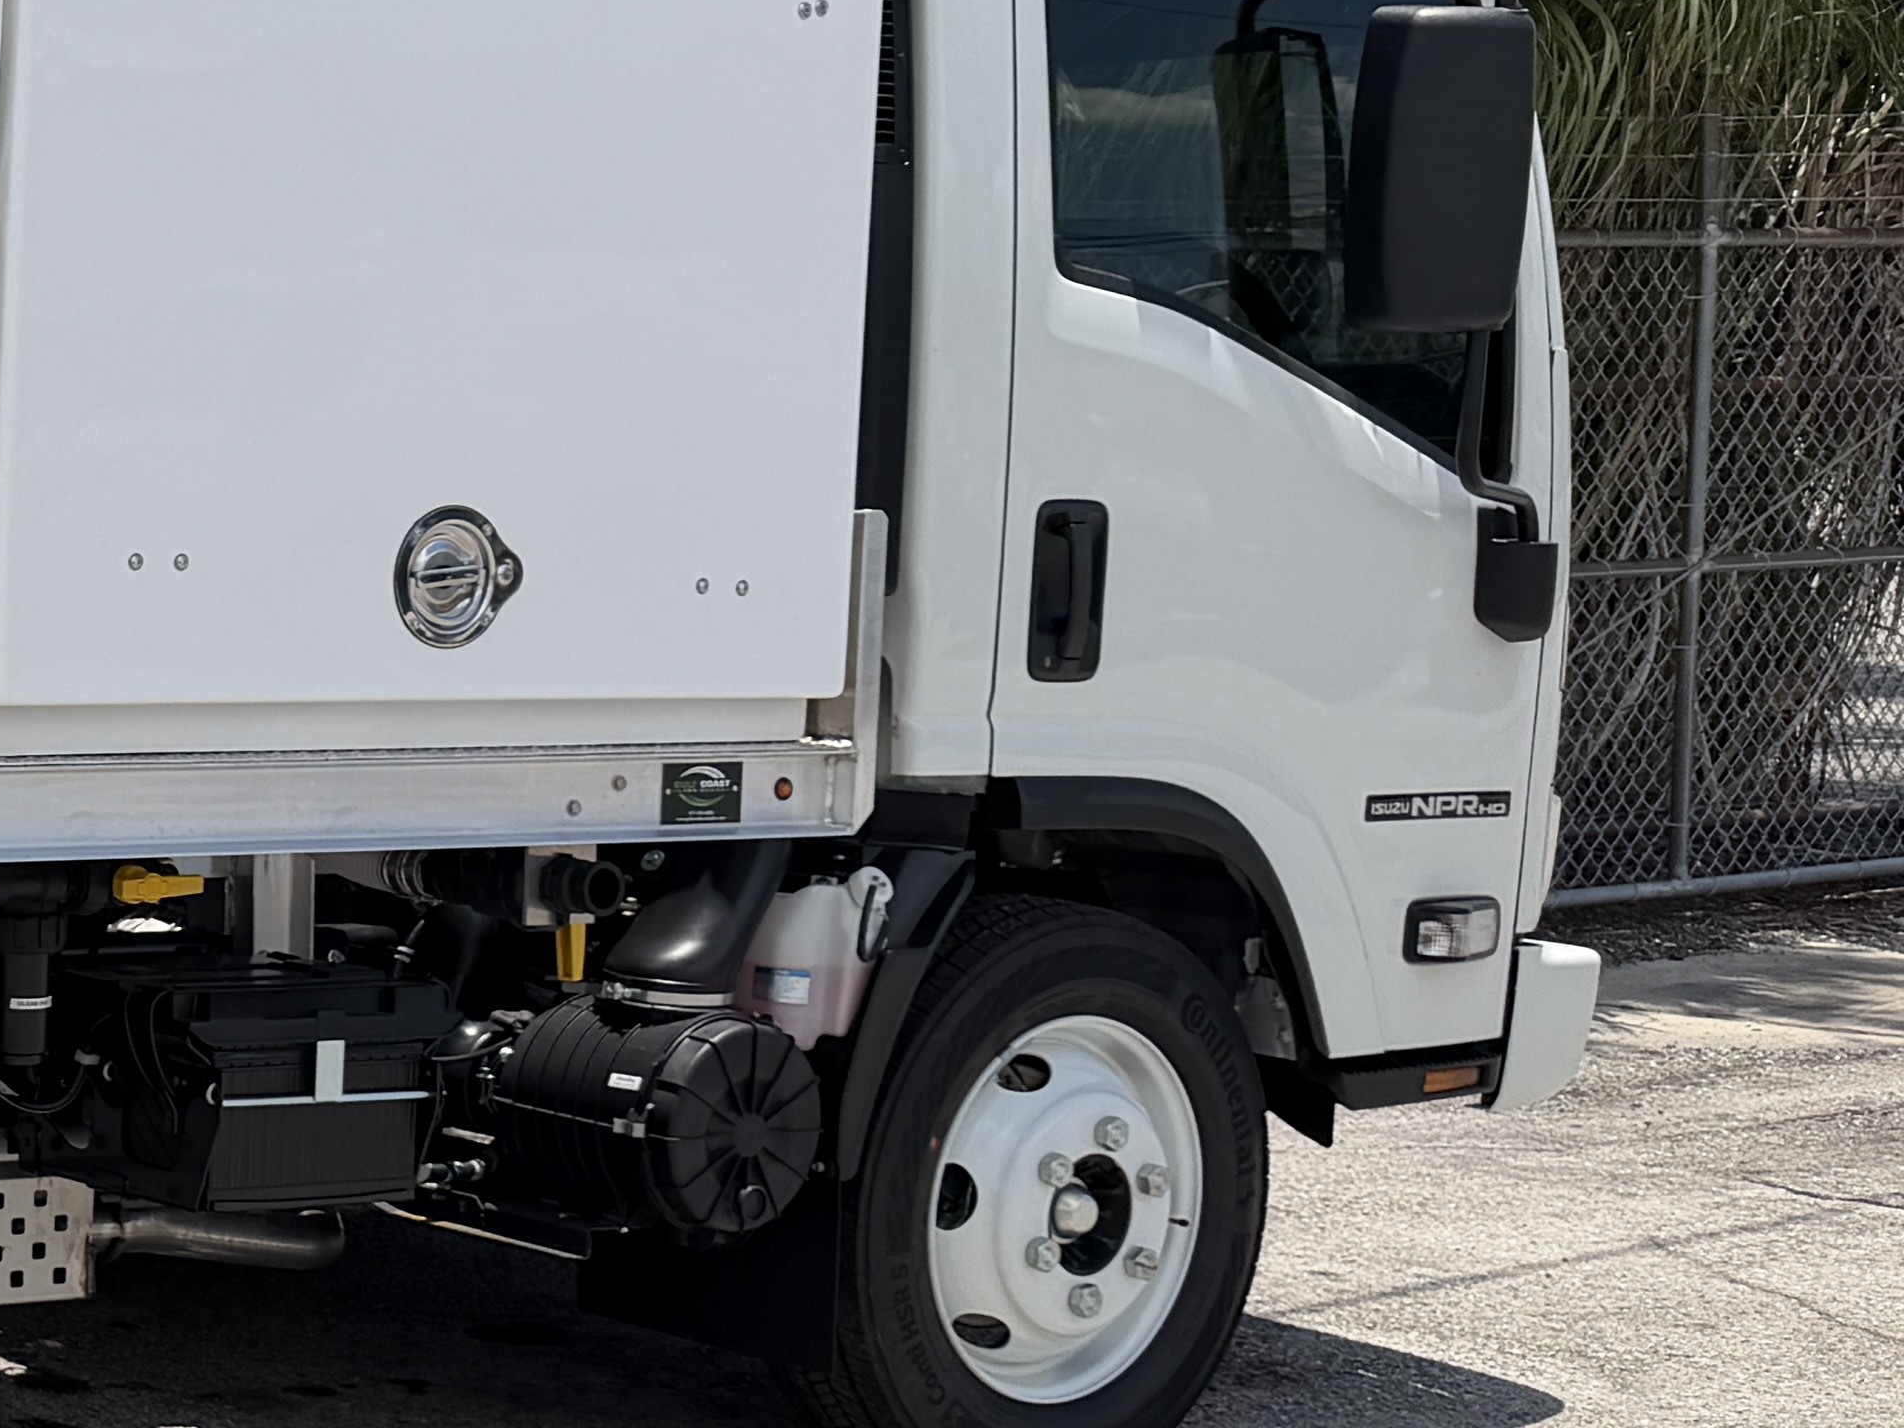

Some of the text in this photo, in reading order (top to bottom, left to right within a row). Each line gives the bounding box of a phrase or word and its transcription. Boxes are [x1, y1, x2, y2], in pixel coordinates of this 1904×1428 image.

[1371, 802, 1409, 815] ISUZU
[1411, 795, 1478, 817] NPR
[1181, 995, 1256, 1180] Continental
